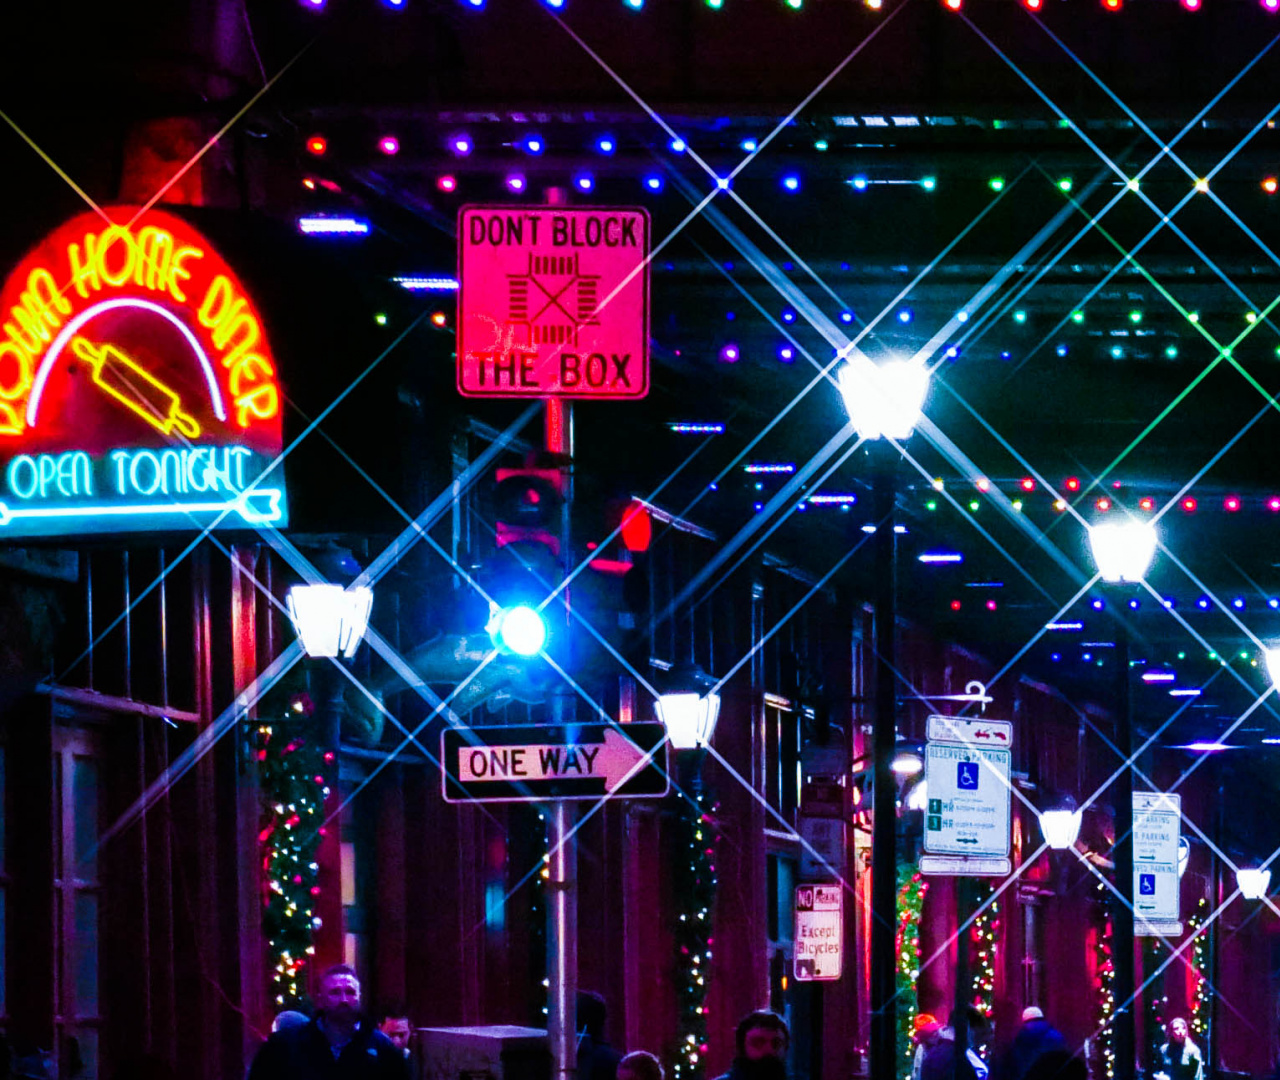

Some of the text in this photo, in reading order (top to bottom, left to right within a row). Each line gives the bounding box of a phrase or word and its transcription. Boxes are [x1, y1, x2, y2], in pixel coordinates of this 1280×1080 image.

[468, 214, 637, 248] DON'T BLOCK
[68, 224, 204, 303] HOME
[198, 274, 279, 428] DINER
[472, 351, 631, 388] THE BOX
[9, 445, 252, 498] OPEN TONIGHT
[469, 746, 600, 778] ONE WAY
[798, 889, 813, 909] NO
[801, 924, 836, 939] Except
[798, 940, 839, 957] Bicycles
